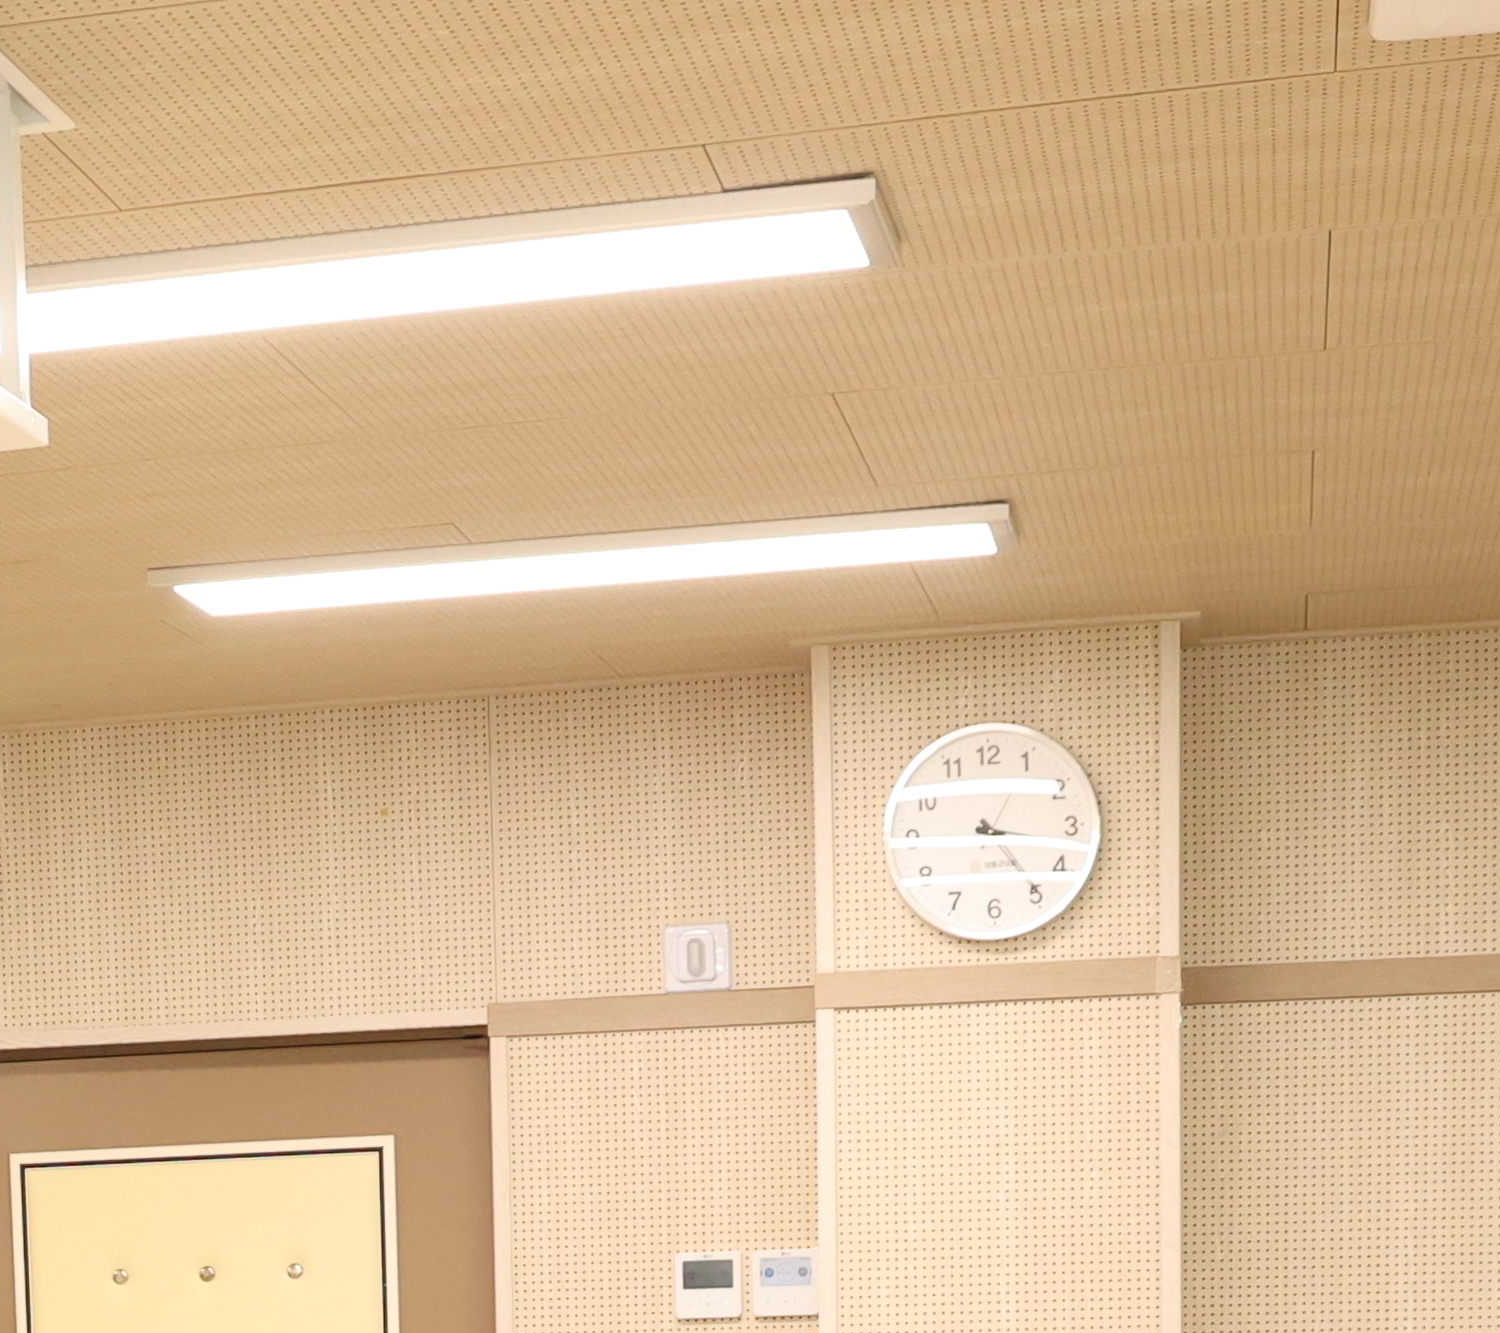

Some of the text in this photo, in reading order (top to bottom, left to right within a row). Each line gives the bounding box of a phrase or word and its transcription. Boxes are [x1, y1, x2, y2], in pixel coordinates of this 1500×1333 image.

[975, 744, 1001, 766] 12
[1020, 751, 1030, 773] 1
[942, 757, 962, 779] 11
[1064, 815, 1079, 837] 3
[1052, 854, 1068, 873] 4
[947, 890, 963, 912] 7
[1029, 884, 1044, 905] 5
[987, 898, 1002, 920] 6
